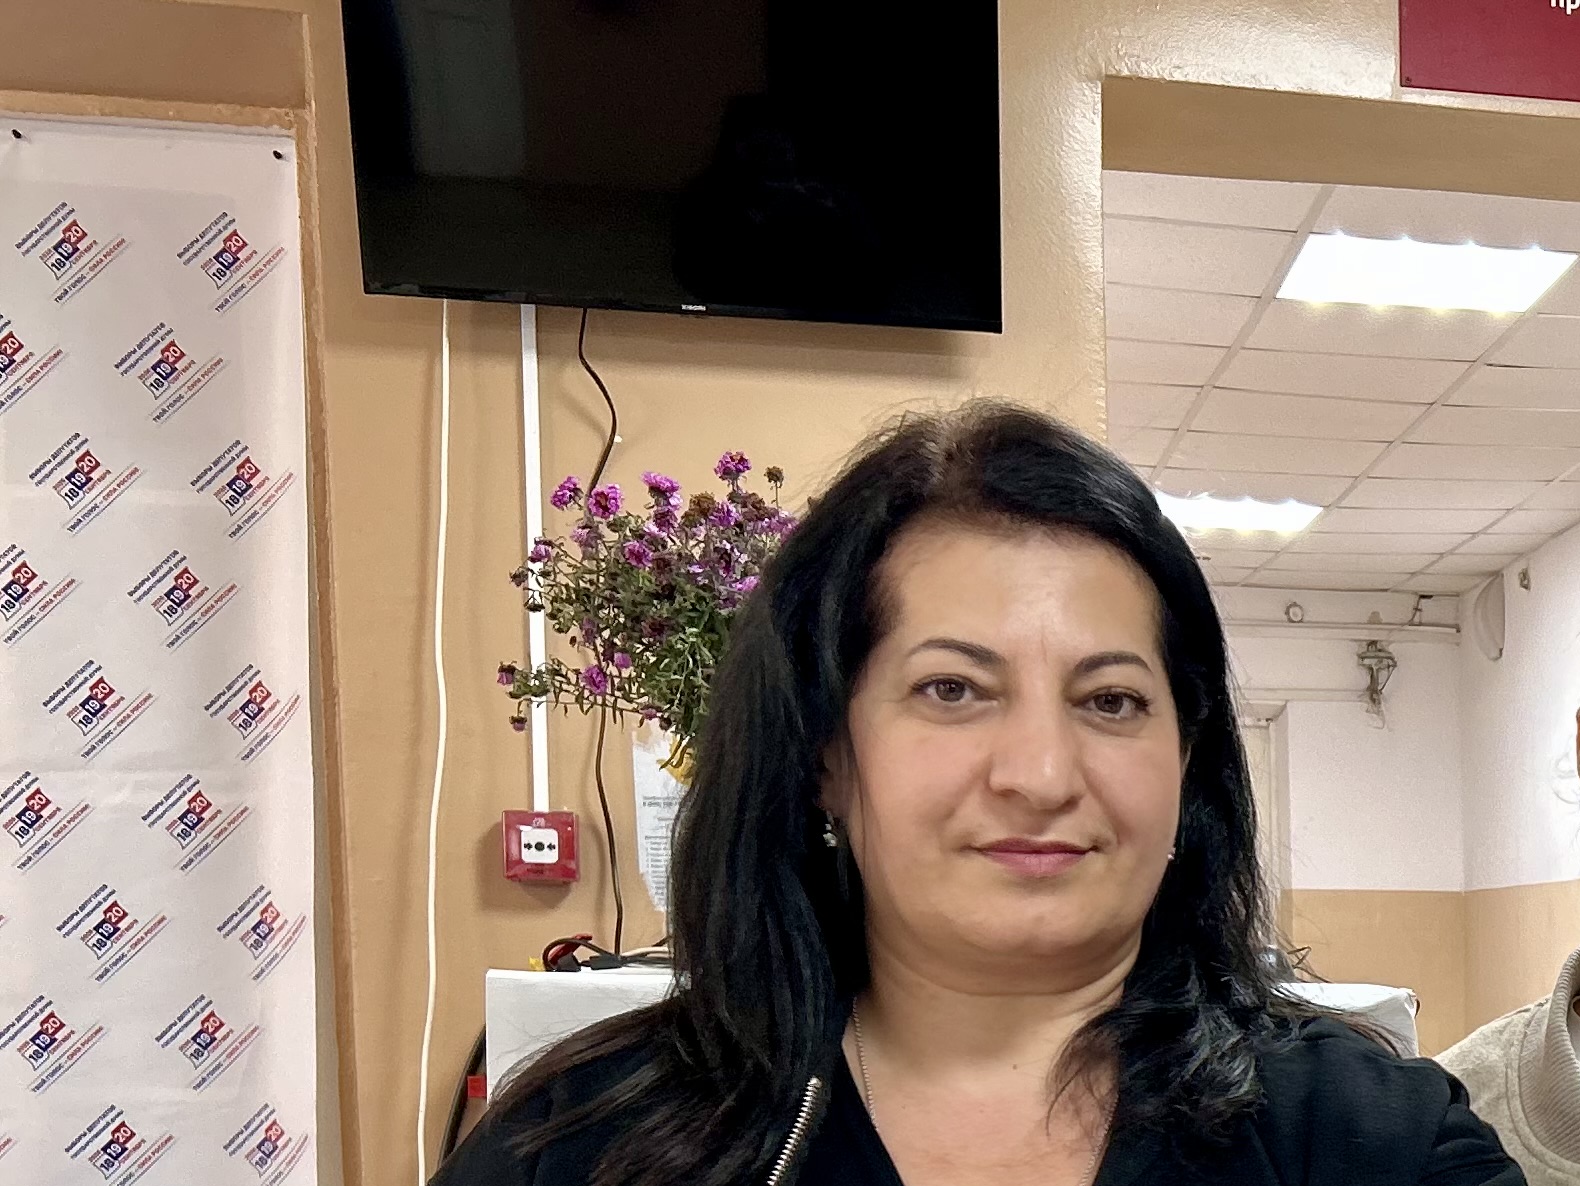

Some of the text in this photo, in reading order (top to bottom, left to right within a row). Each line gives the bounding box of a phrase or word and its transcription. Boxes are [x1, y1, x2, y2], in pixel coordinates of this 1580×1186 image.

[51, 224, 82, 272] 18 19 20
[212, 234, 243, 282] 18 19 20
[2, 336, 19, 354] 20
[149, 344, 180, 392] 18 19 20
[64, 454, 96, 502] 18 19 20
[225, 461, 255, 509] 18 19 20
[0, 565, 32, 614] 18 19 20
[163, 571, 194, 619] 18 19 20
[78, 681, 109, 729] 18 19 20
[252, 685, 266, 703] 20
[14, 792, 46, 840] 18 19 20
[176, 795, 207, 842] 18 19 20
[92, 905, 123, 952] 18 19 20
[263, 906, 276, 923] 20
[28, 1016, 60, 1063] 18 19 20
[190, 1015, 220, 1062] 18 19 20
[100, 1125, 131, 1172] 18 19 20
[268, 1124, 280, 1141] 20
